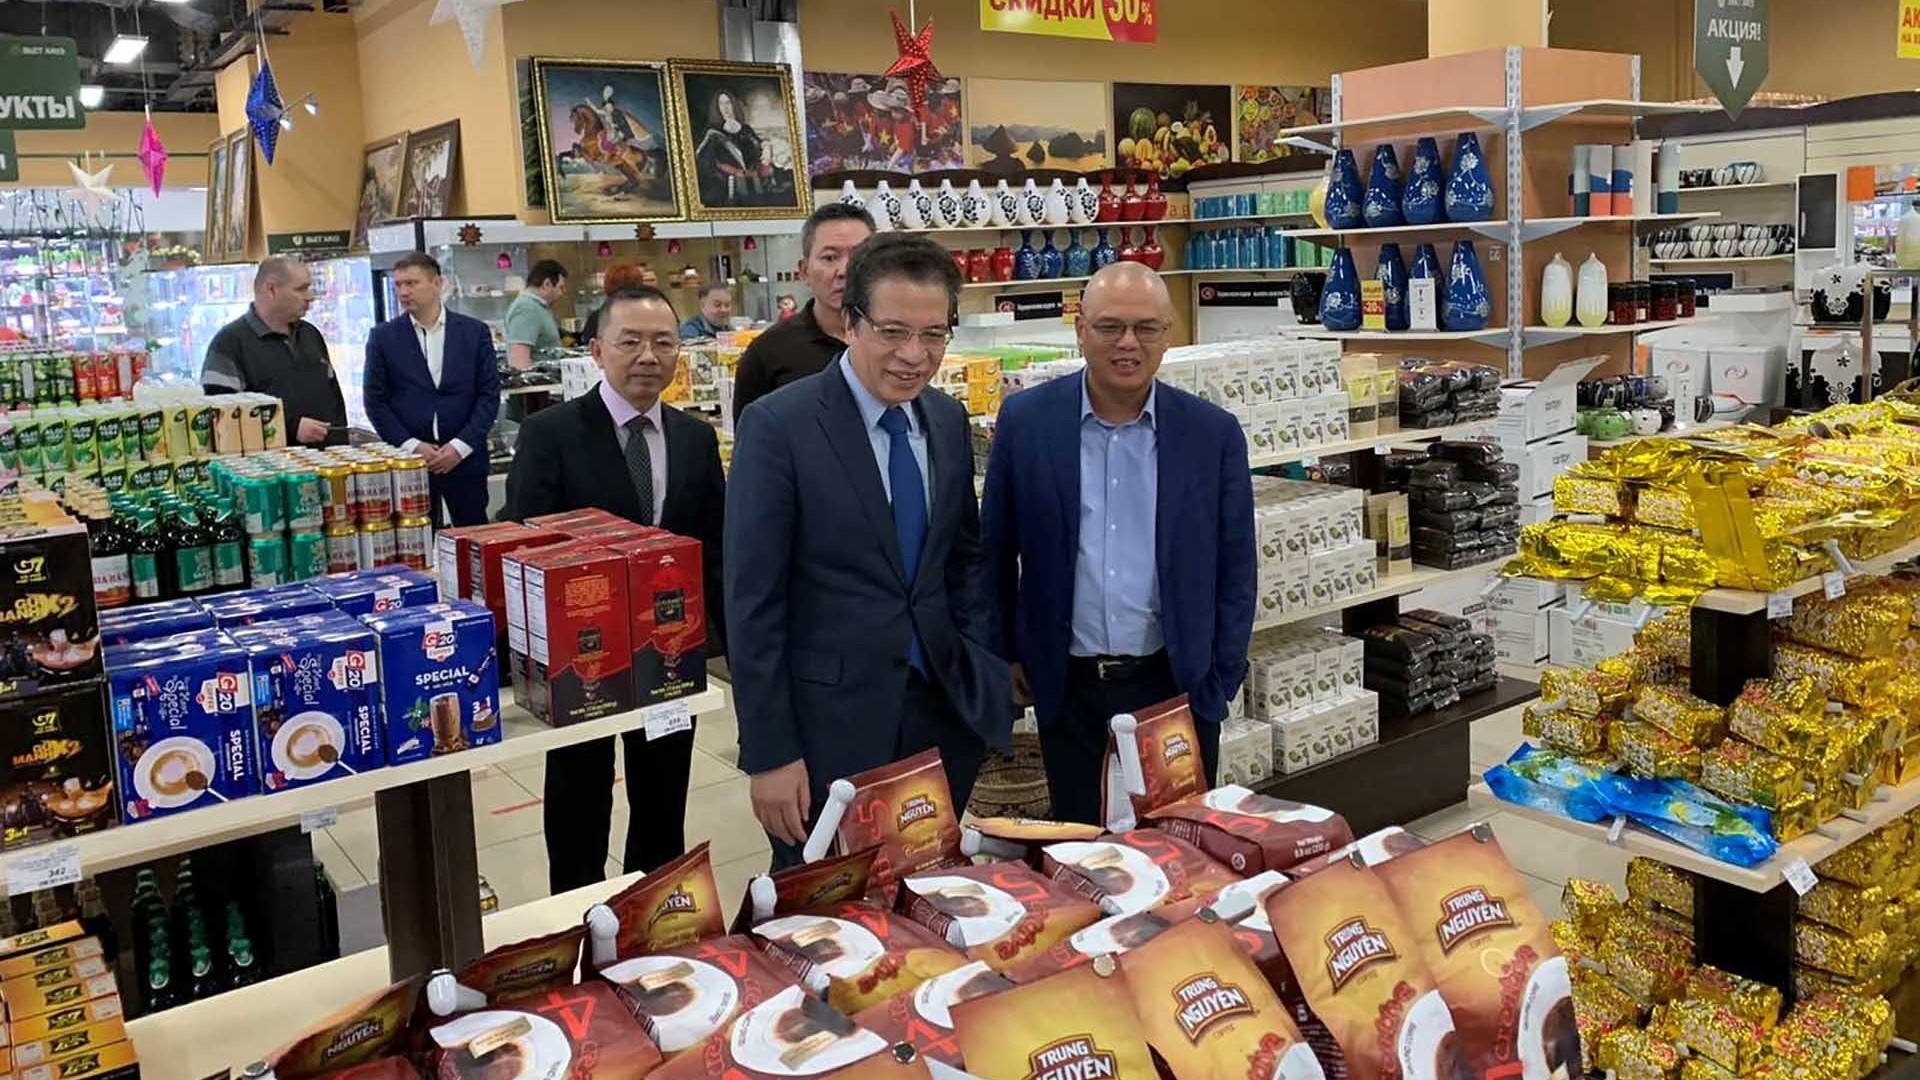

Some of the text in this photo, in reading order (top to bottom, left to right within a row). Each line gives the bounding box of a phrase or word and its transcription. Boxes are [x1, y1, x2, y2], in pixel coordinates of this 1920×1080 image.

[1707, 18, 1761, 42] АКЦИЯ!
[415, 665, 470, 686] SPECIAL
[358, 705, 372, 755] SPECIAL
[230, 730, 245, 781] SPECIAL
[1449, 889, 1485, 913] TRUNG
[1331, 922, 1364, 948] TRUNG
[1179, 976, 1218, 1001] TRUNG
[1038, 1041, 1089, 1068] TRUNG
